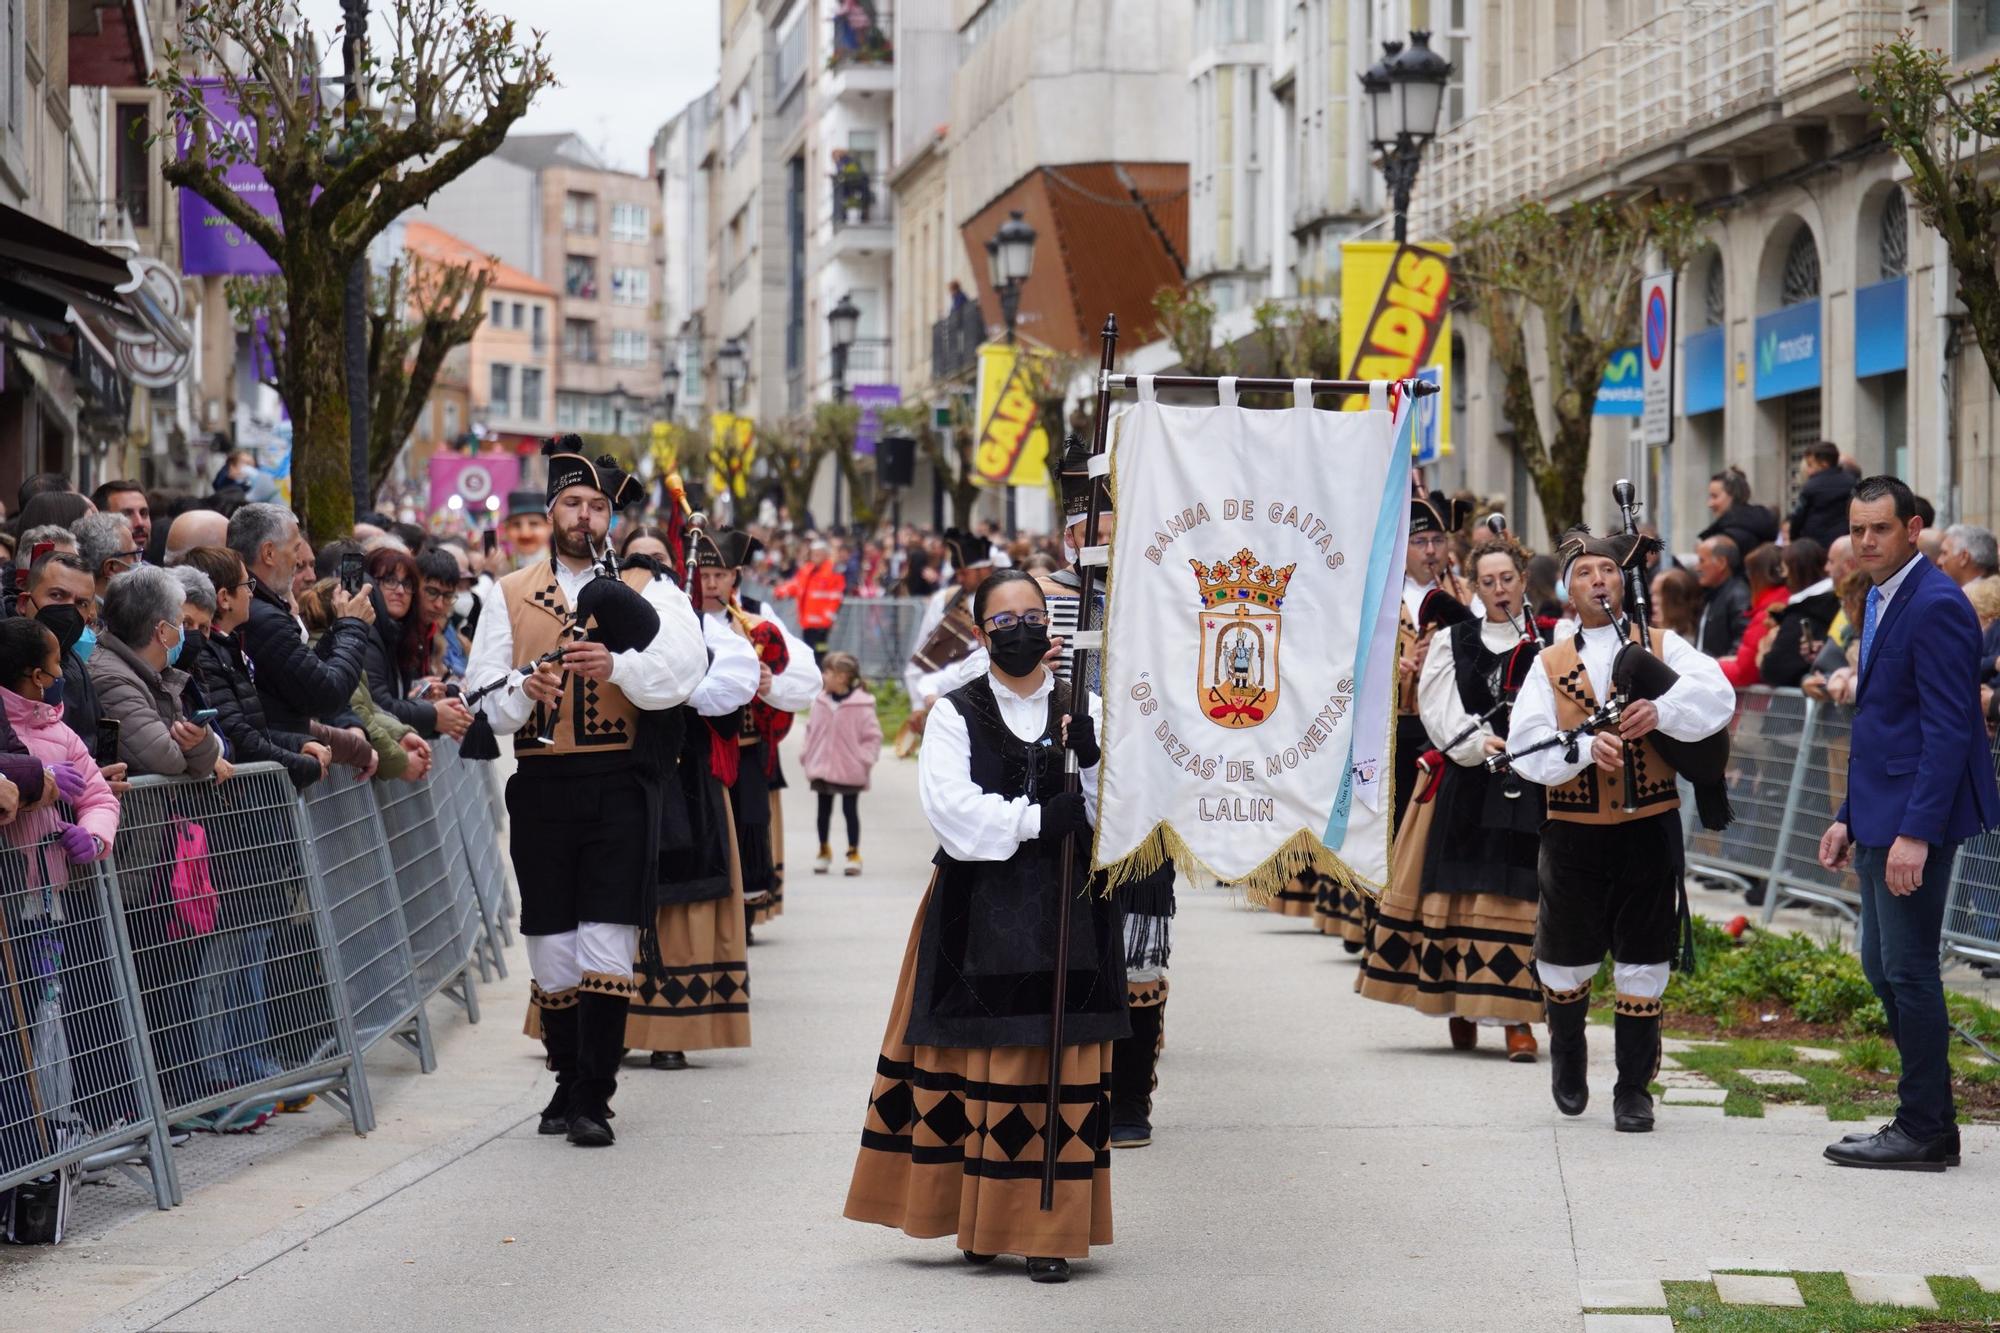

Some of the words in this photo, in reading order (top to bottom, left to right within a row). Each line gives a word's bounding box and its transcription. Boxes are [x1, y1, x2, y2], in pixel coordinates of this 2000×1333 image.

[1342, 250, 1450, 412] ADIS
[1145, 503, 1210, 566] BANDA
[1223, 499, 1254, 521] DE
[1268, 502, 1345, 570] GAITAS
[1226, 760, 1255, 783] DE
[1265, 678, 1354, 777] MONEIXAS
[1198, 798, 1274, 822] LALIN
